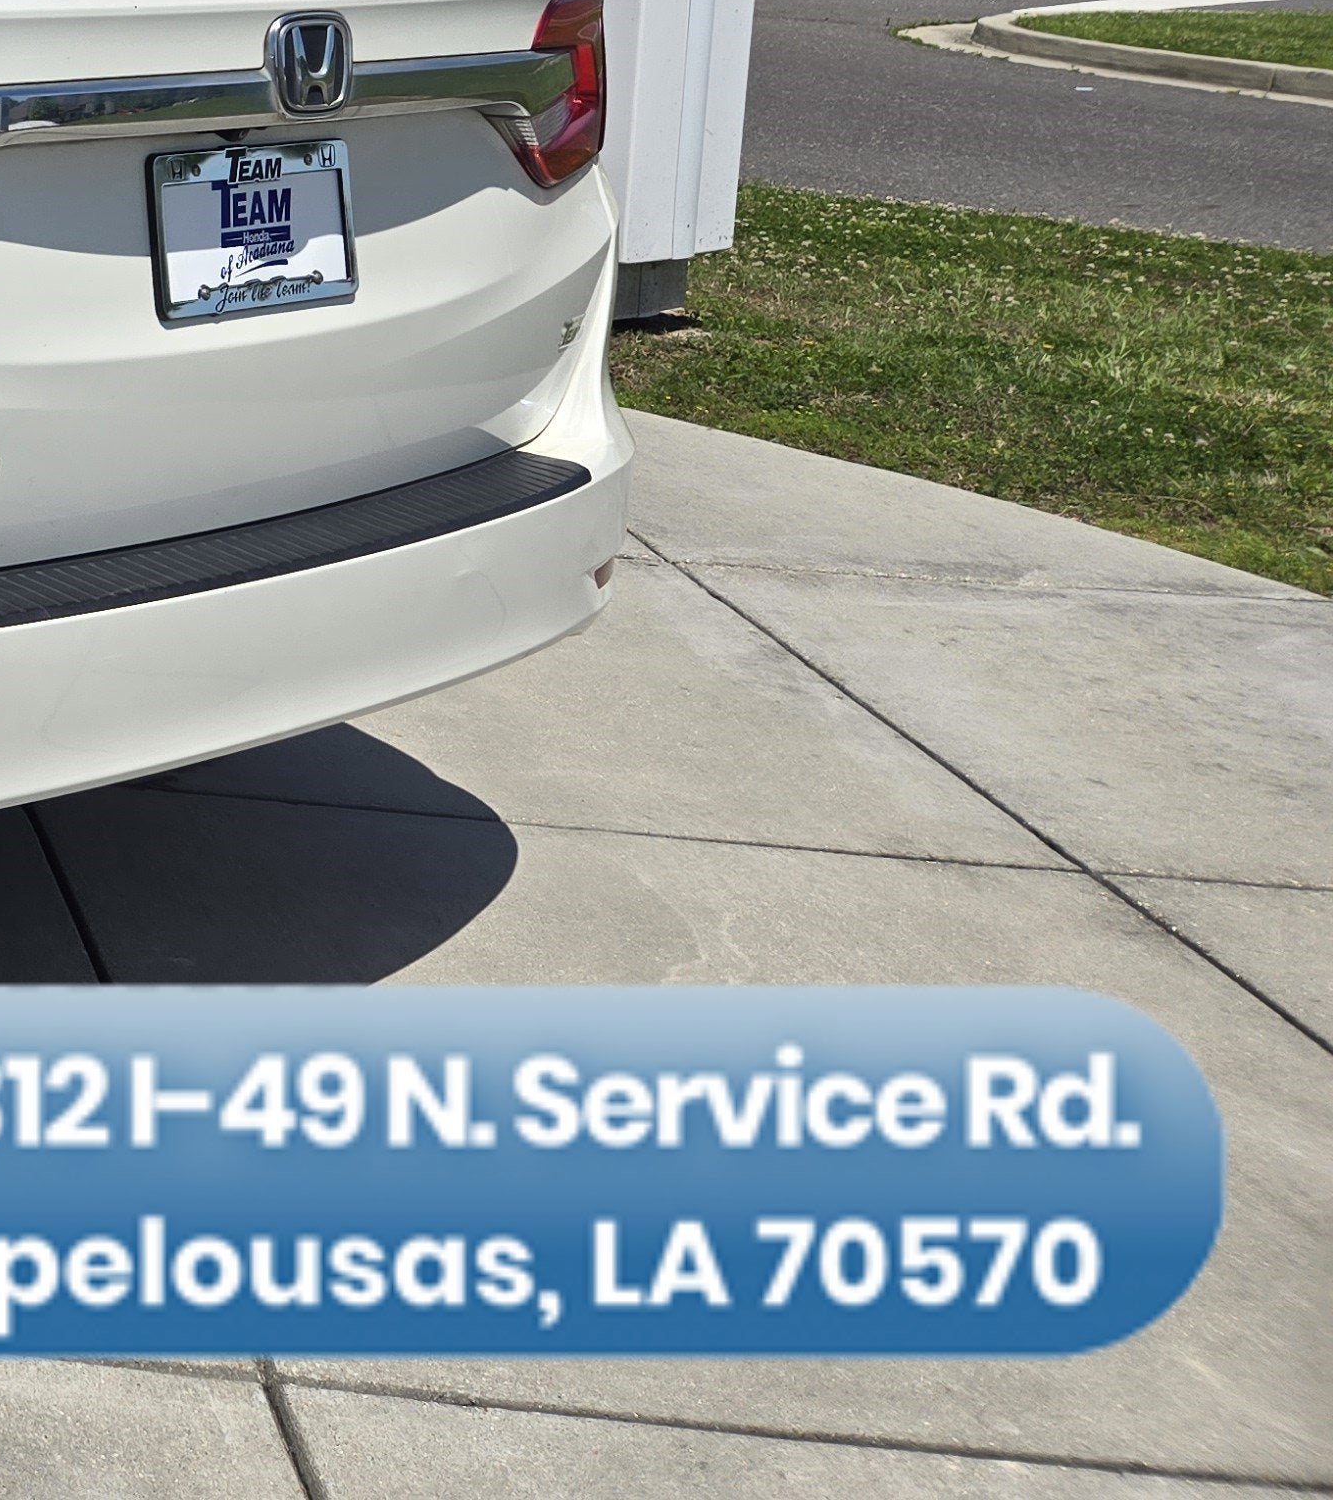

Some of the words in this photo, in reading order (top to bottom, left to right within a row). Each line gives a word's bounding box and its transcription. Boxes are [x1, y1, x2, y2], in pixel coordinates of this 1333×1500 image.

[225, 147, 282, 184] TEAM
[212, 181, 291, 229] TEAM
[221, 253, 234, 282] of
[236, 240, 295, 269] Acadiana
